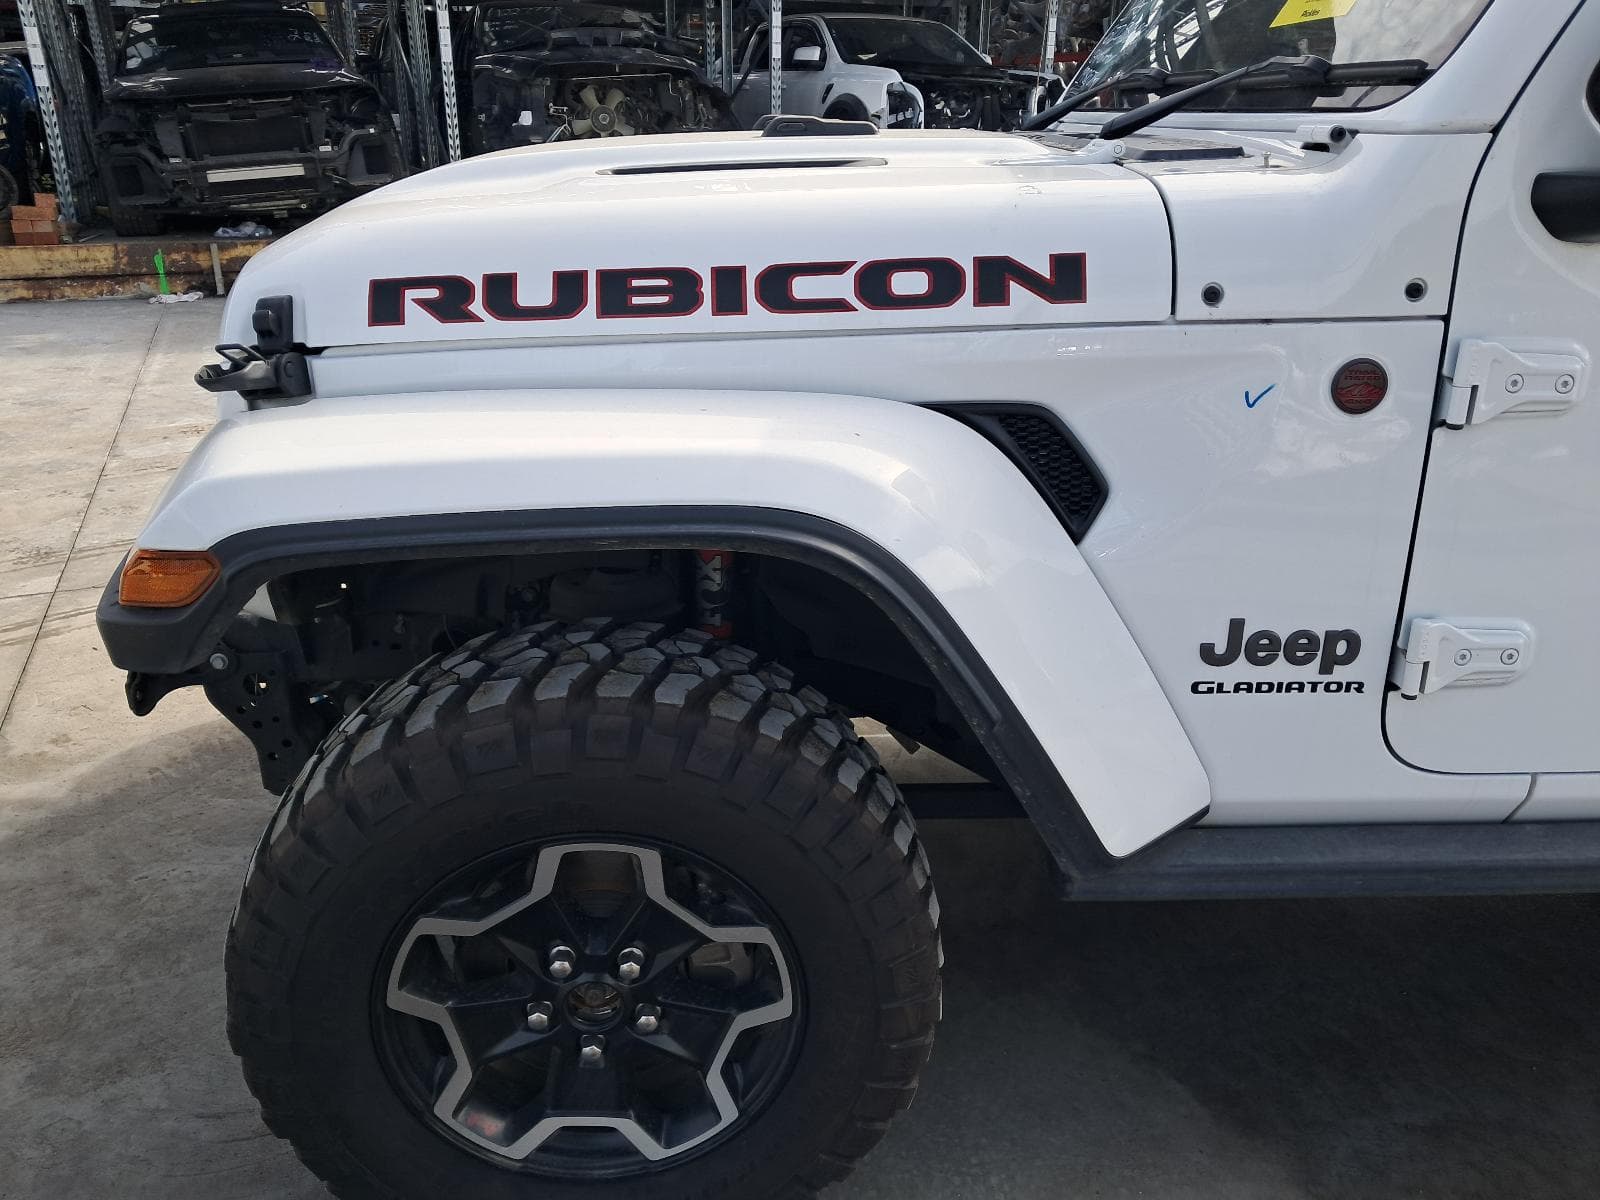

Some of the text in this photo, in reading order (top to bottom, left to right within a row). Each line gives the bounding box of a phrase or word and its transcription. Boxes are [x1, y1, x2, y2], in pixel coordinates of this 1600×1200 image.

[367, 252, 1087, 326] RUBICON
[1199, 617, 1361, 676] Jeep
[1191, 680, 1365, 695] GLADIATOR
